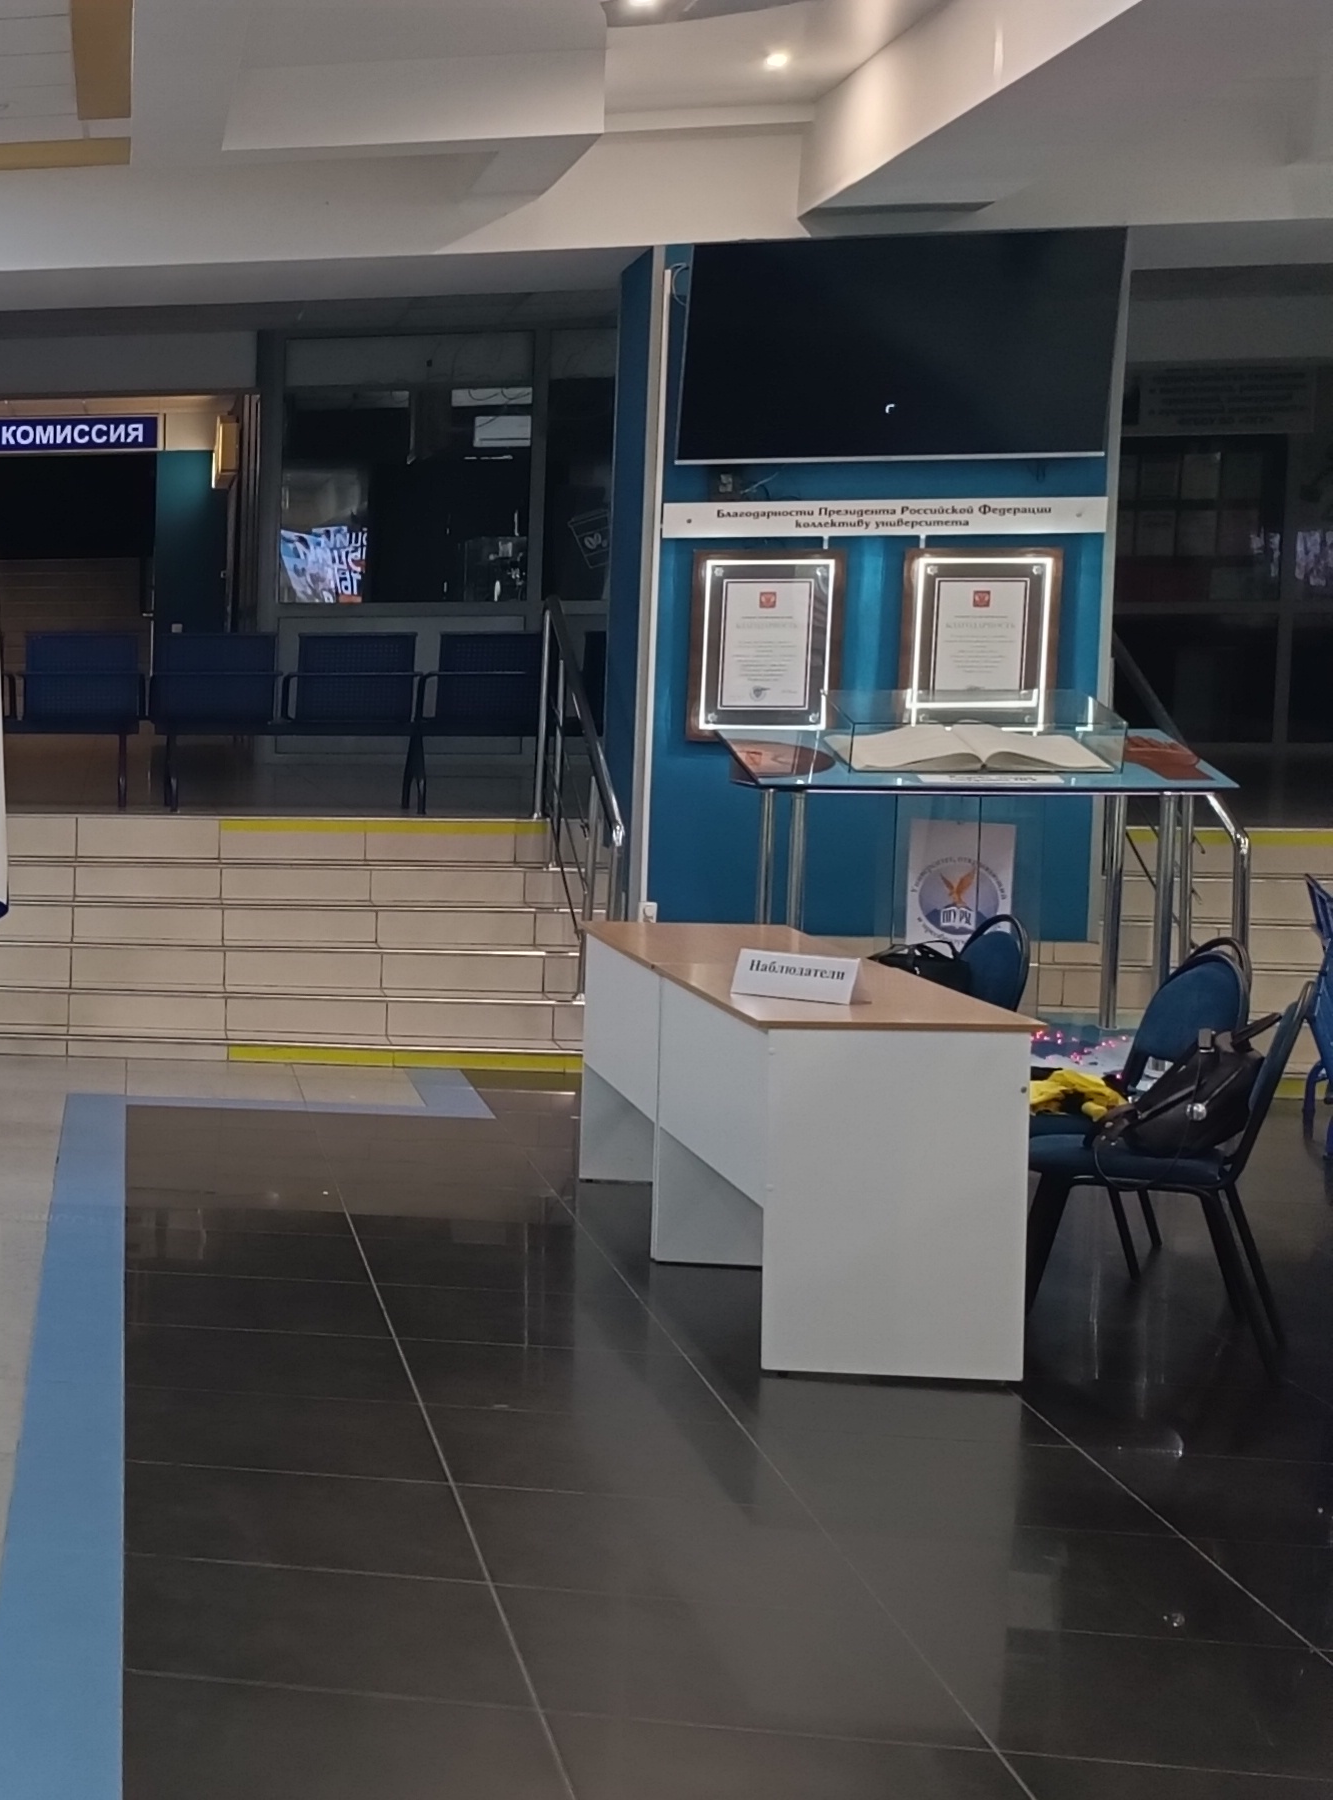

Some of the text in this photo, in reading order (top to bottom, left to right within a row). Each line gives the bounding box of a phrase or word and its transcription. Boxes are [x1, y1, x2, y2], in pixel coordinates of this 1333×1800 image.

[1, 422, 144, 446] КОМИССИЯ
[716, 504, 1052, 519] Благодарности Президента Российской Федерации
[795, 518, 970, 529] коллективу университета
[748, 958, 846, 981] Наблюдатели
